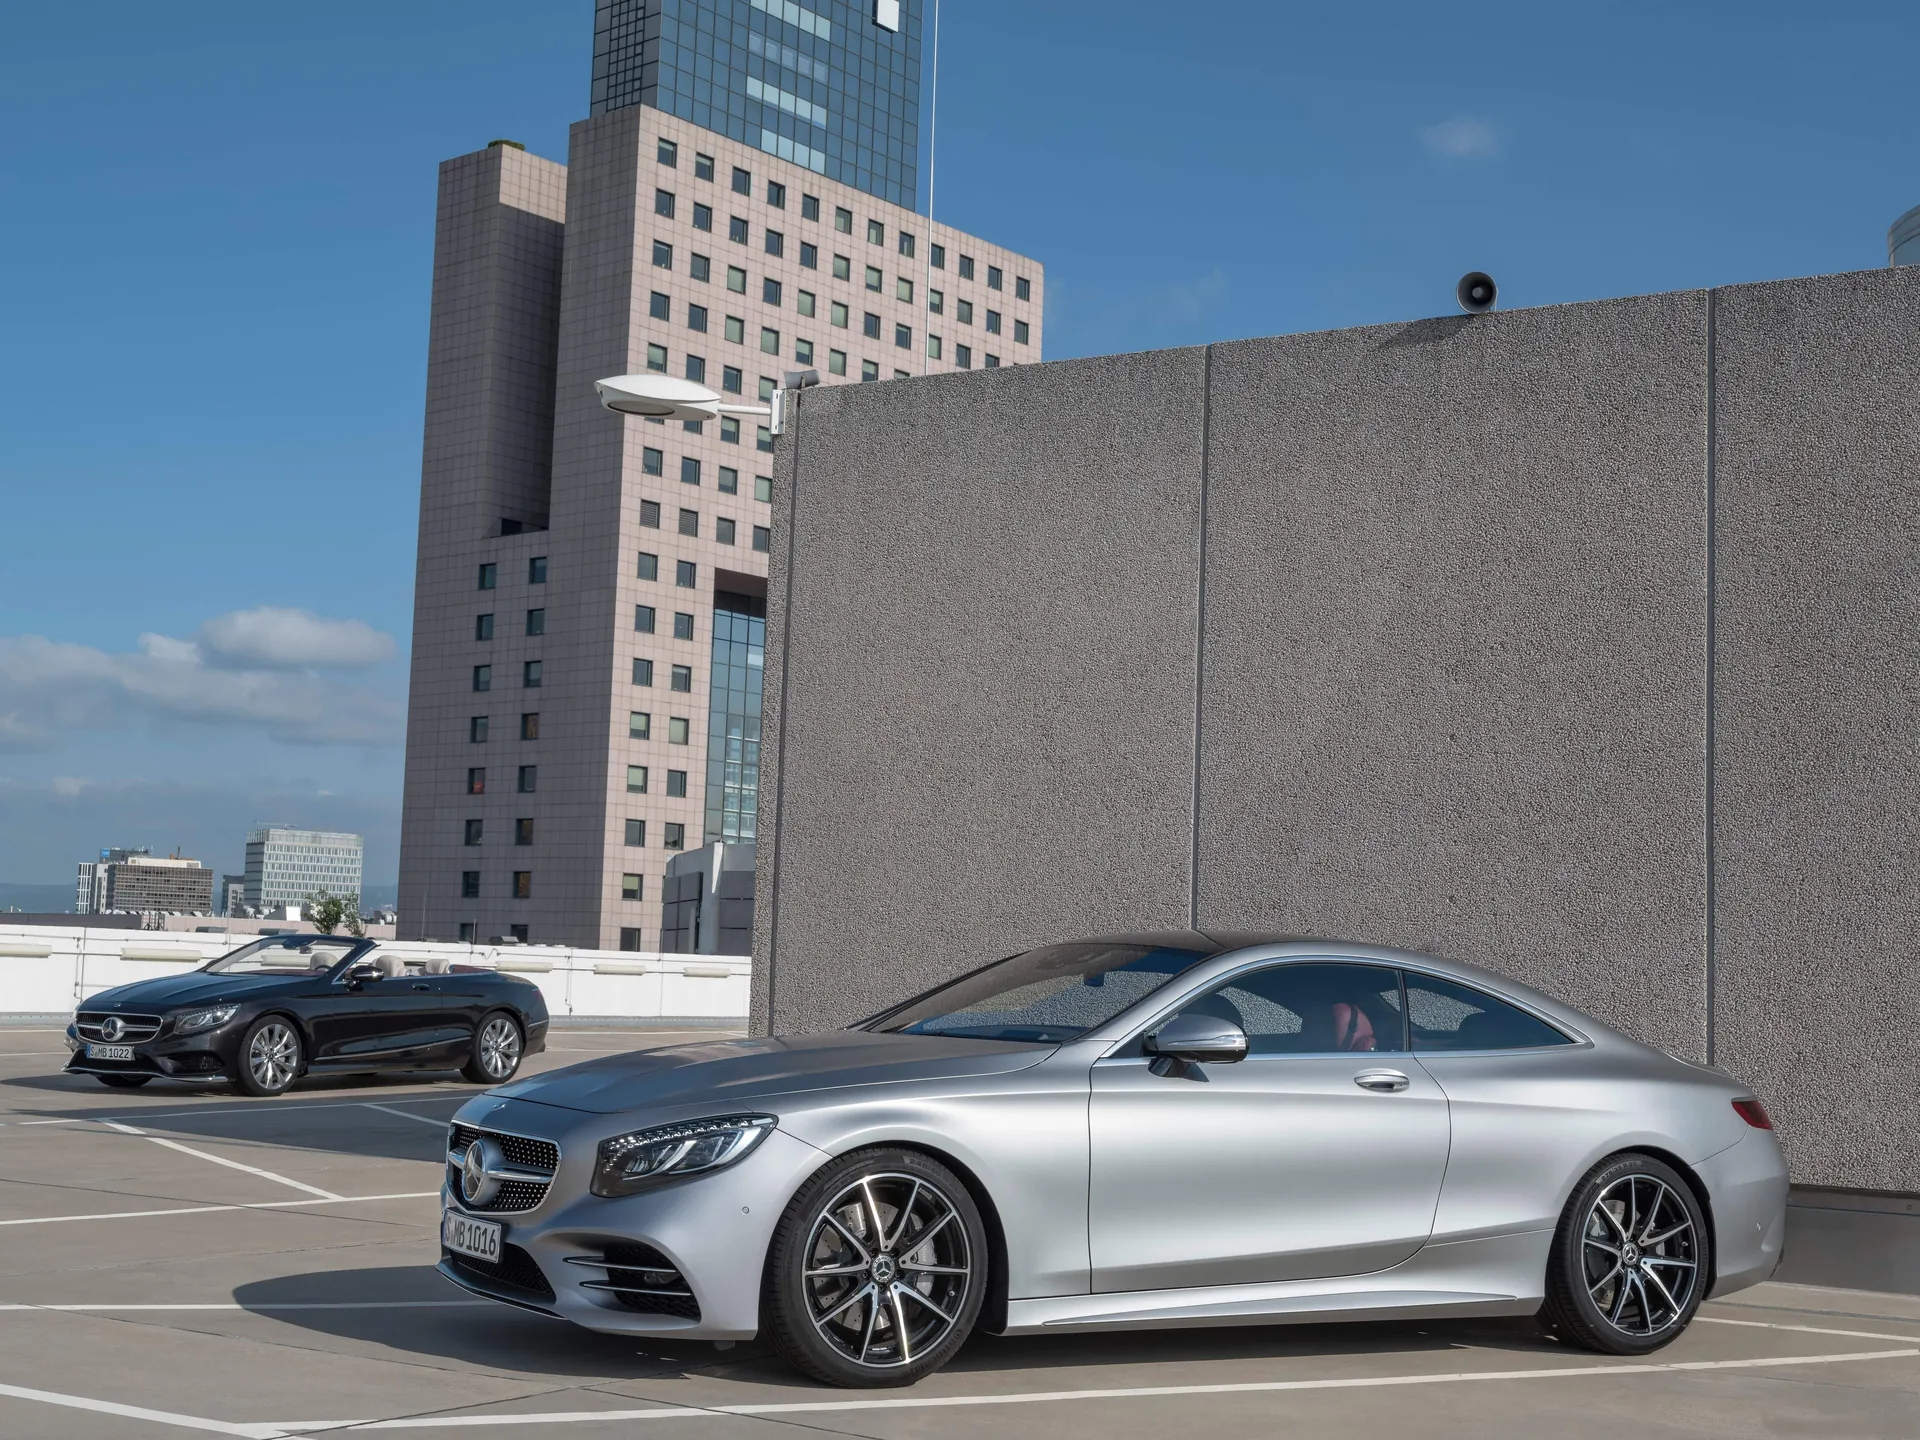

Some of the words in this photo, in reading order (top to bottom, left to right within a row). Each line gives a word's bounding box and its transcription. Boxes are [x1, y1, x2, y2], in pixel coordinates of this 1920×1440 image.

[98, 1047, 107, 1057] MB
[109, 1048, 130, 1058] 1022
[446, 1216, 452, 1242] S
[453, 1219, 466, 1248] MB
[466, 1224, 497, 1256] 1016
